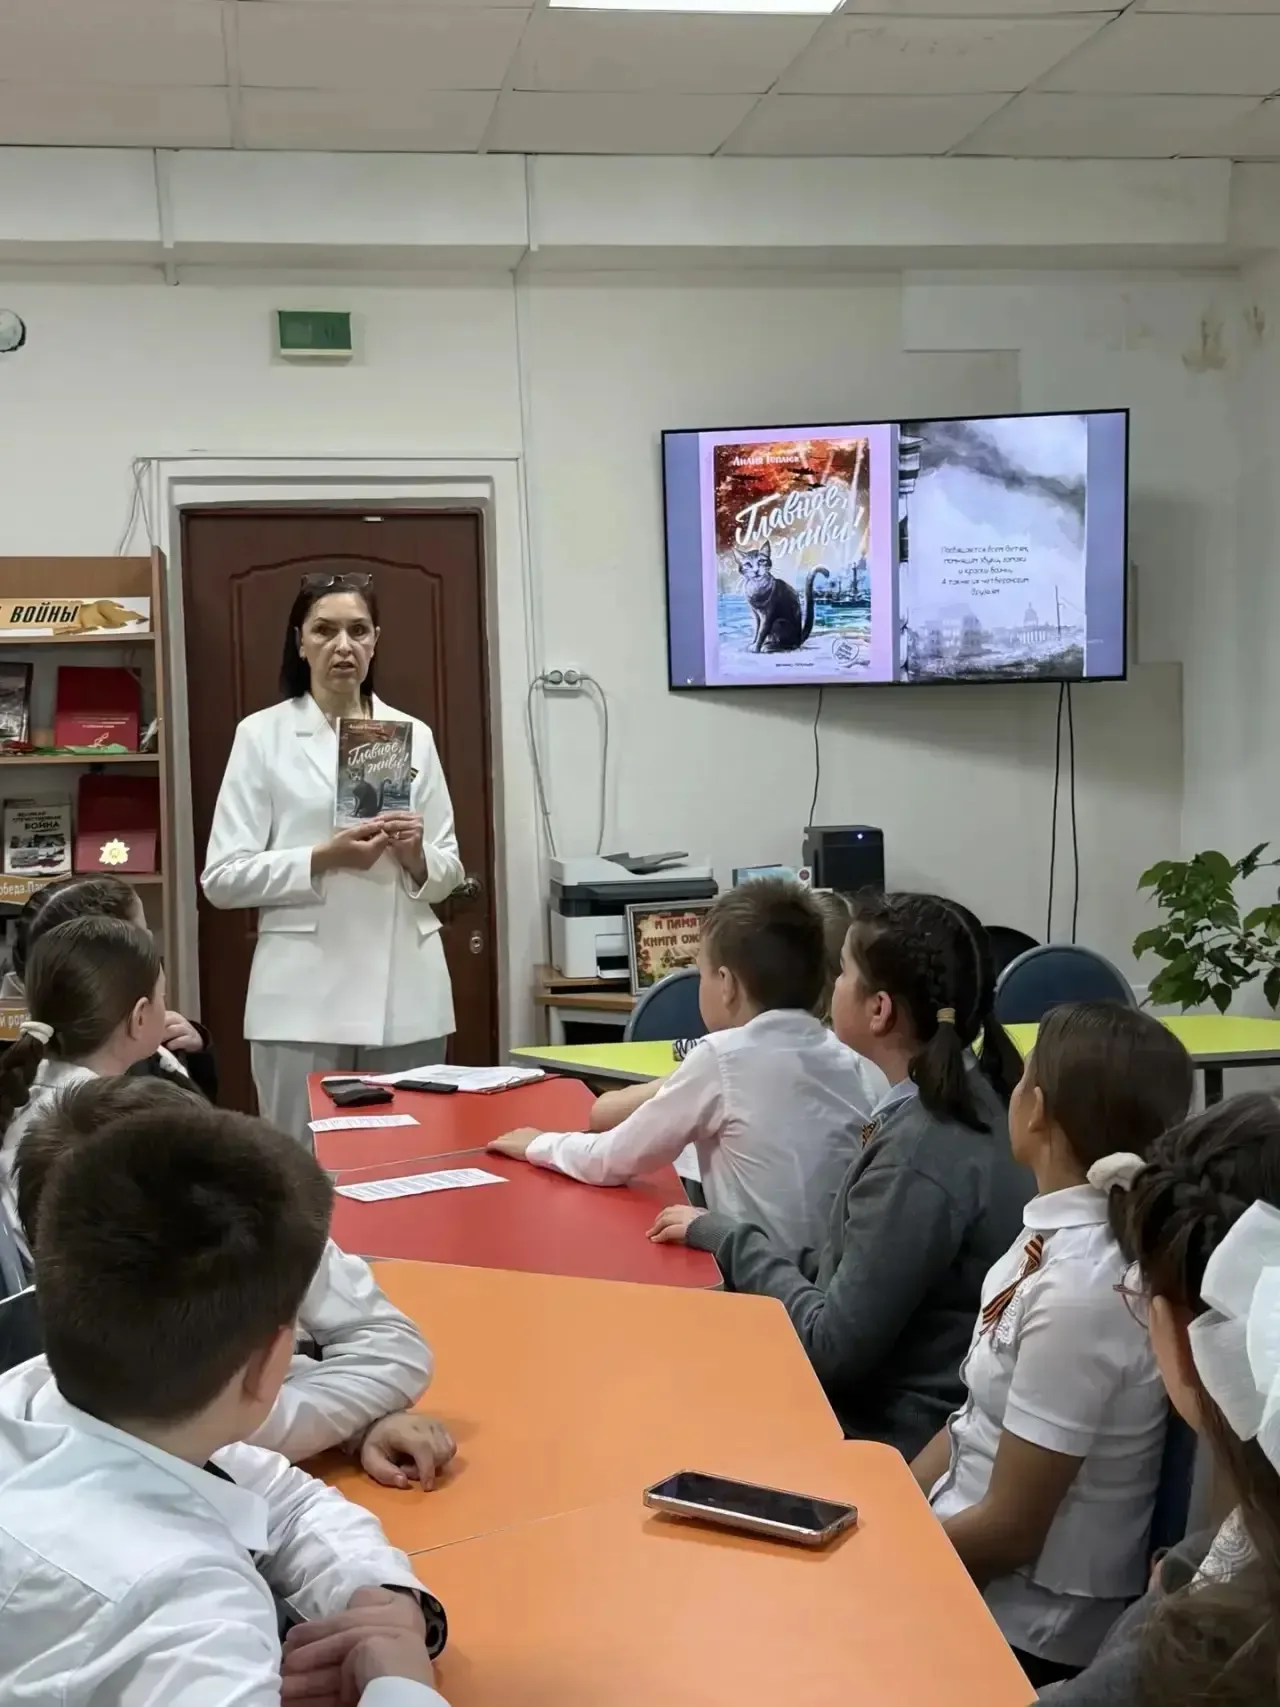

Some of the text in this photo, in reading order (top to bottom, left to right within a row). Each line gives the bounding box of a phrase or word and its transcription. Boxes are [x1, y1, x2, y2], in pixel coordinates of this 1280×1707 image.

[774, 506, 864, 558] живи!
[9, 601, 79, 623] ВОЙНЫ
[24, 821, 61, 830] ВОЙНА
[643, 935, 677, 947] КНИГА
